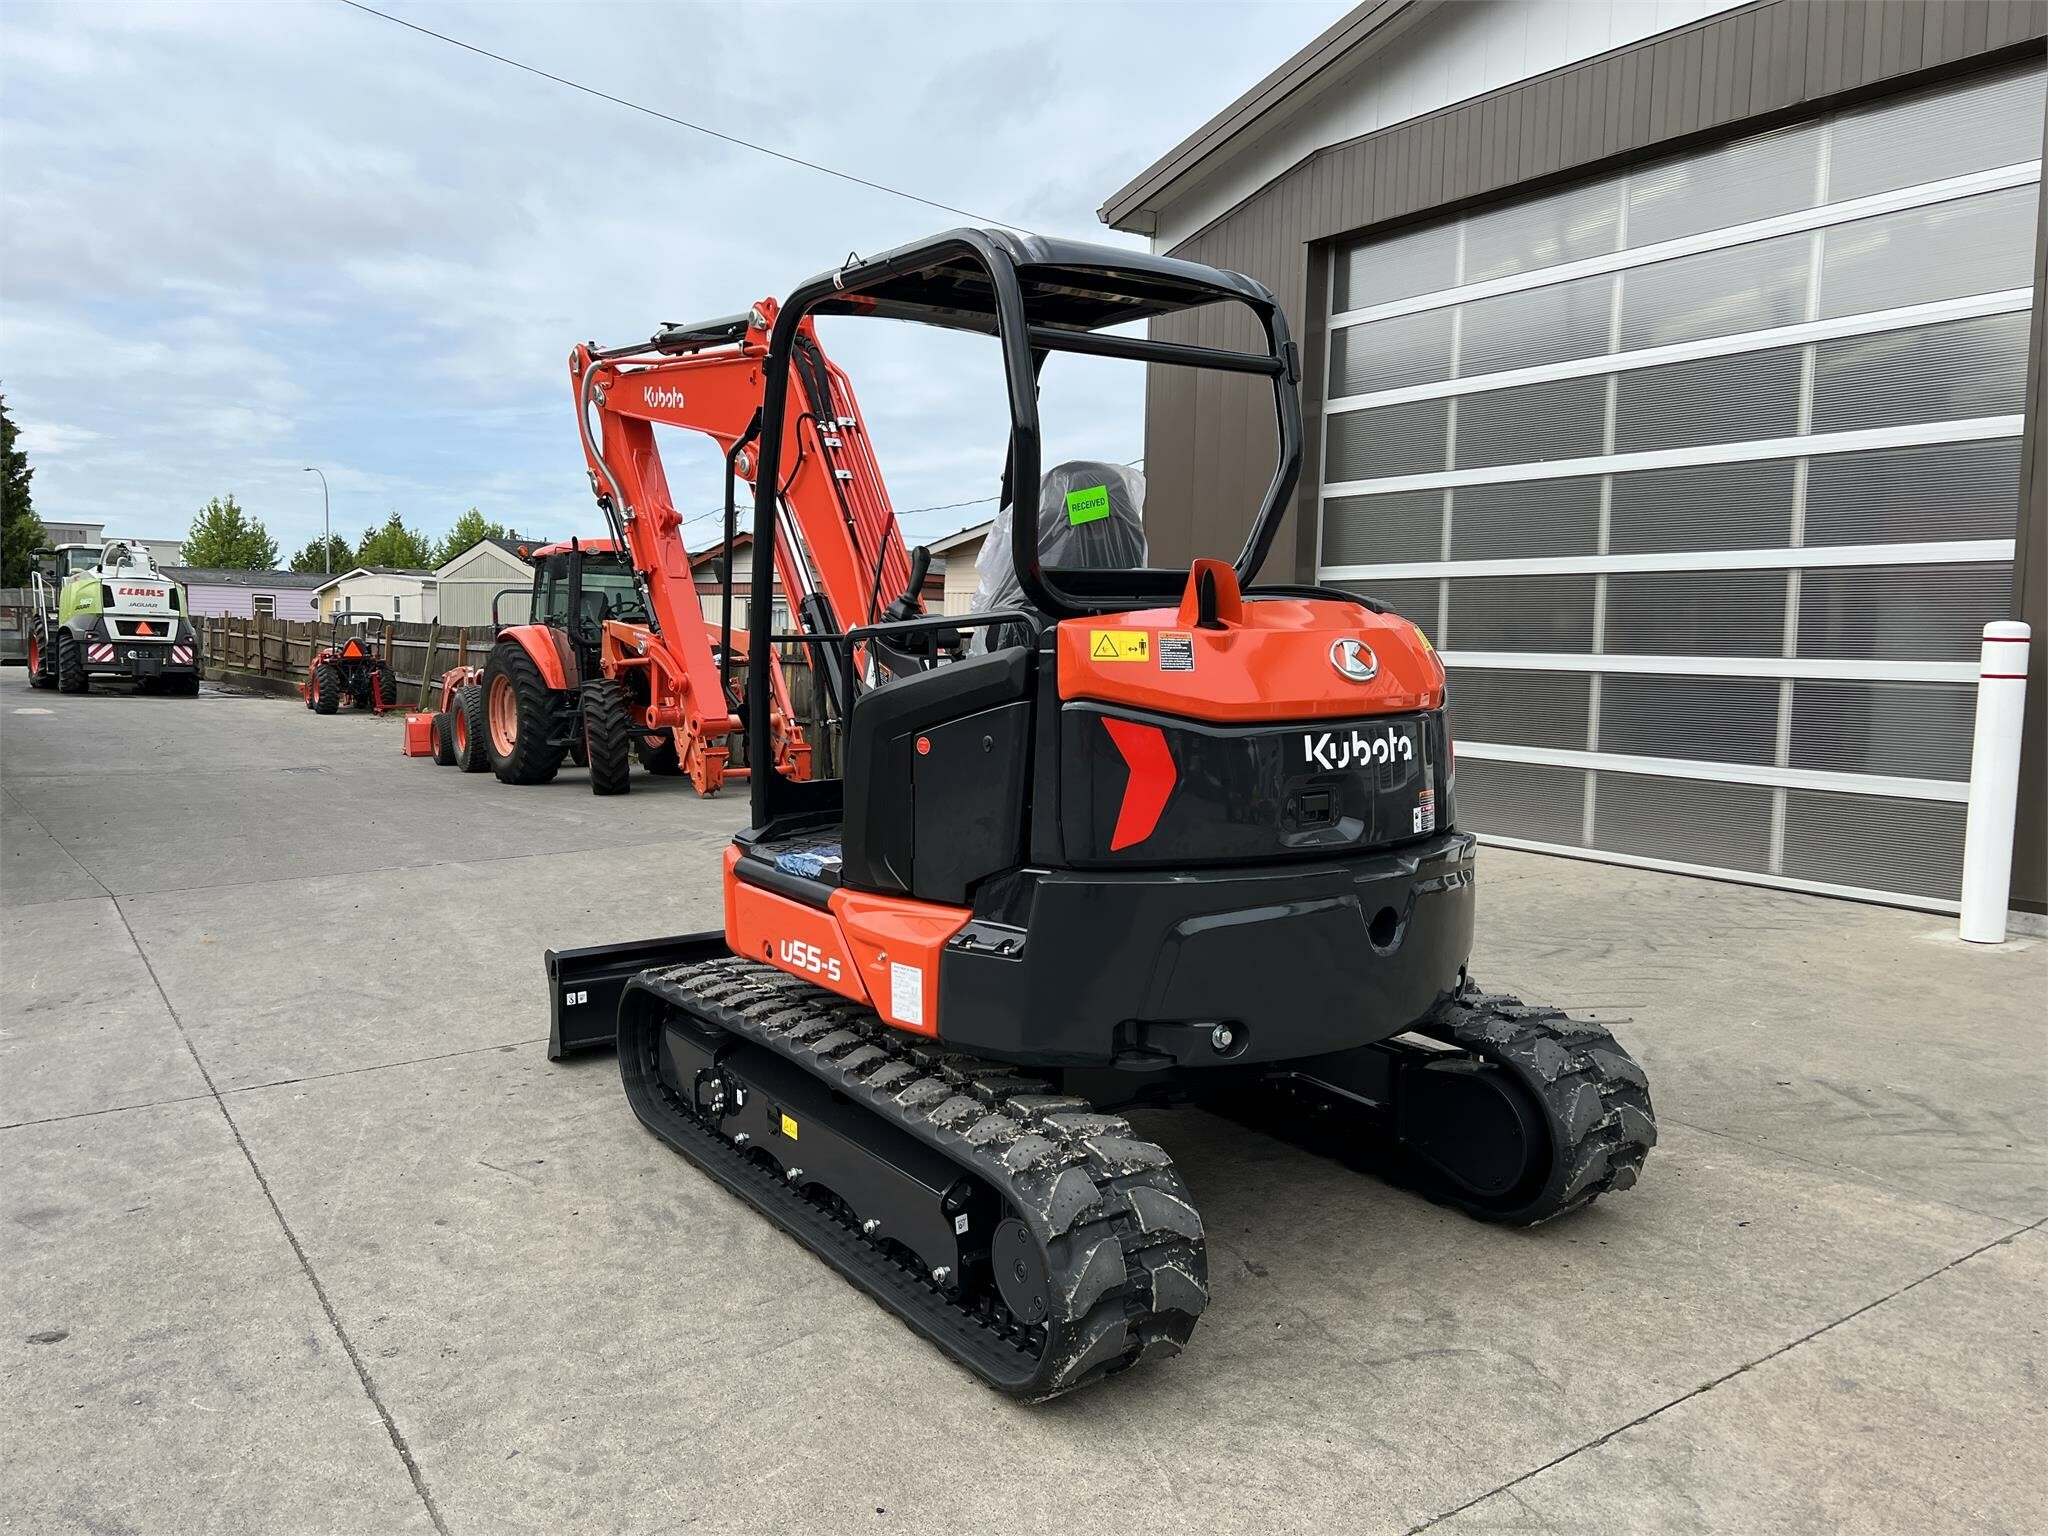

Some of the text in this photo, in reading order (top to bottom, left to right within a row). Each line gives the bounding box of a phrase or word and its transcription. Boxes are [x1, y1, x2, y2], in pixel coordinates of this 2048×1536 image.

[643, 385, 685, 409] Kubota
[1071, 497, 1106, 512] RECEIVED
[118, 587, 165, 597] CLAAS
[1304, 727, 1413, 770] Kubota
